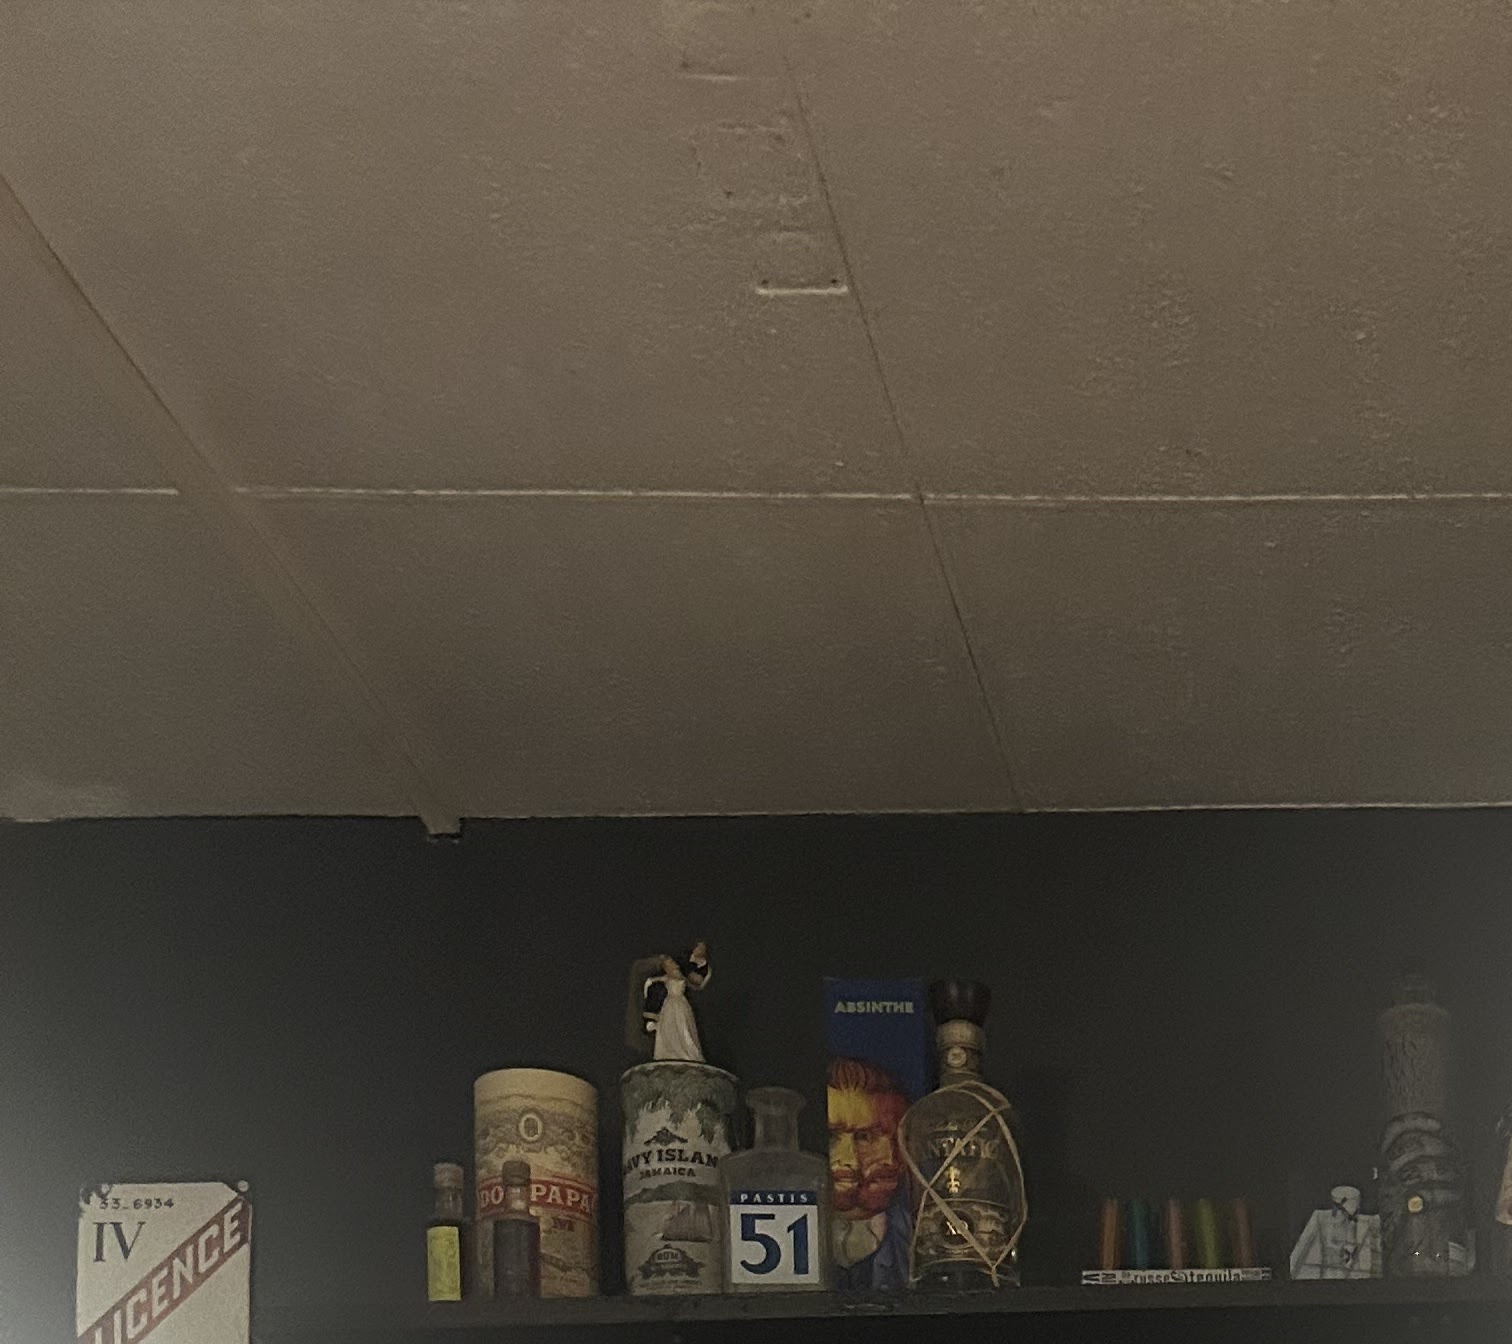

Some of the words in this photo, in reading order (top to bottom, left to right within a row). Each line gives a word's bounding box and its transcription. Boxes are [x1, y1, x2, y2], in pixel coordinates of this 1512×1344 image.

[834, 1000, 915, 1014] ABSINTHE
[657, 1148, 719, 1169] ISLAN
[531, 1185, 591, 1213] PAPA
[740, 1192, 809, 1204] PASTIS
[92, 1221, 146, 1263] IV
[740, 1213, 809, 1275] 51
